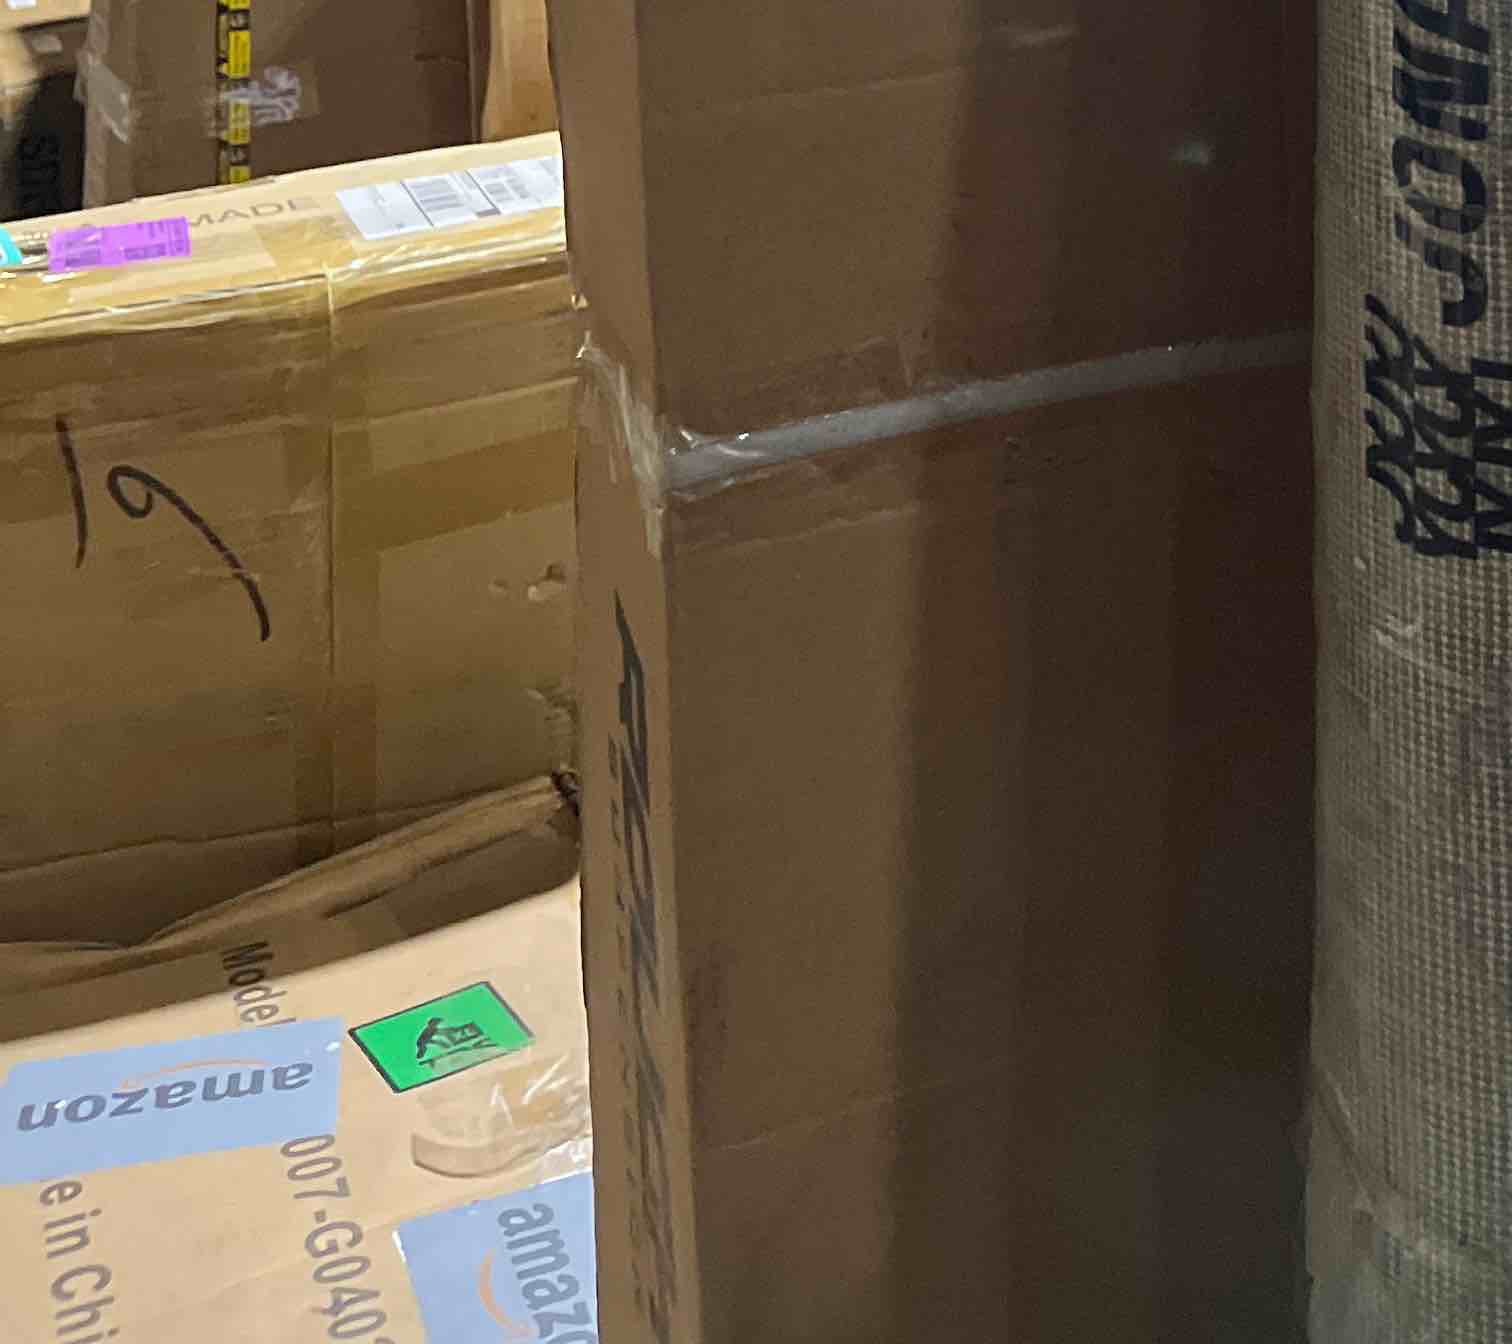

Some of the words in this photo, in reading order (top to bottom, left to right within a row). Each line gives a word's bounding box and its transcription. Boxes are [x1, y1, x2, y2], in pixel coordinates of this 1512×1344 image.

[220, 941, 298, 1028] Model
[17, 1061, 314, 1132] amazon
[43, 1208, 102, 1260] in
[280, 1133, 396, 1344] 007-G040
